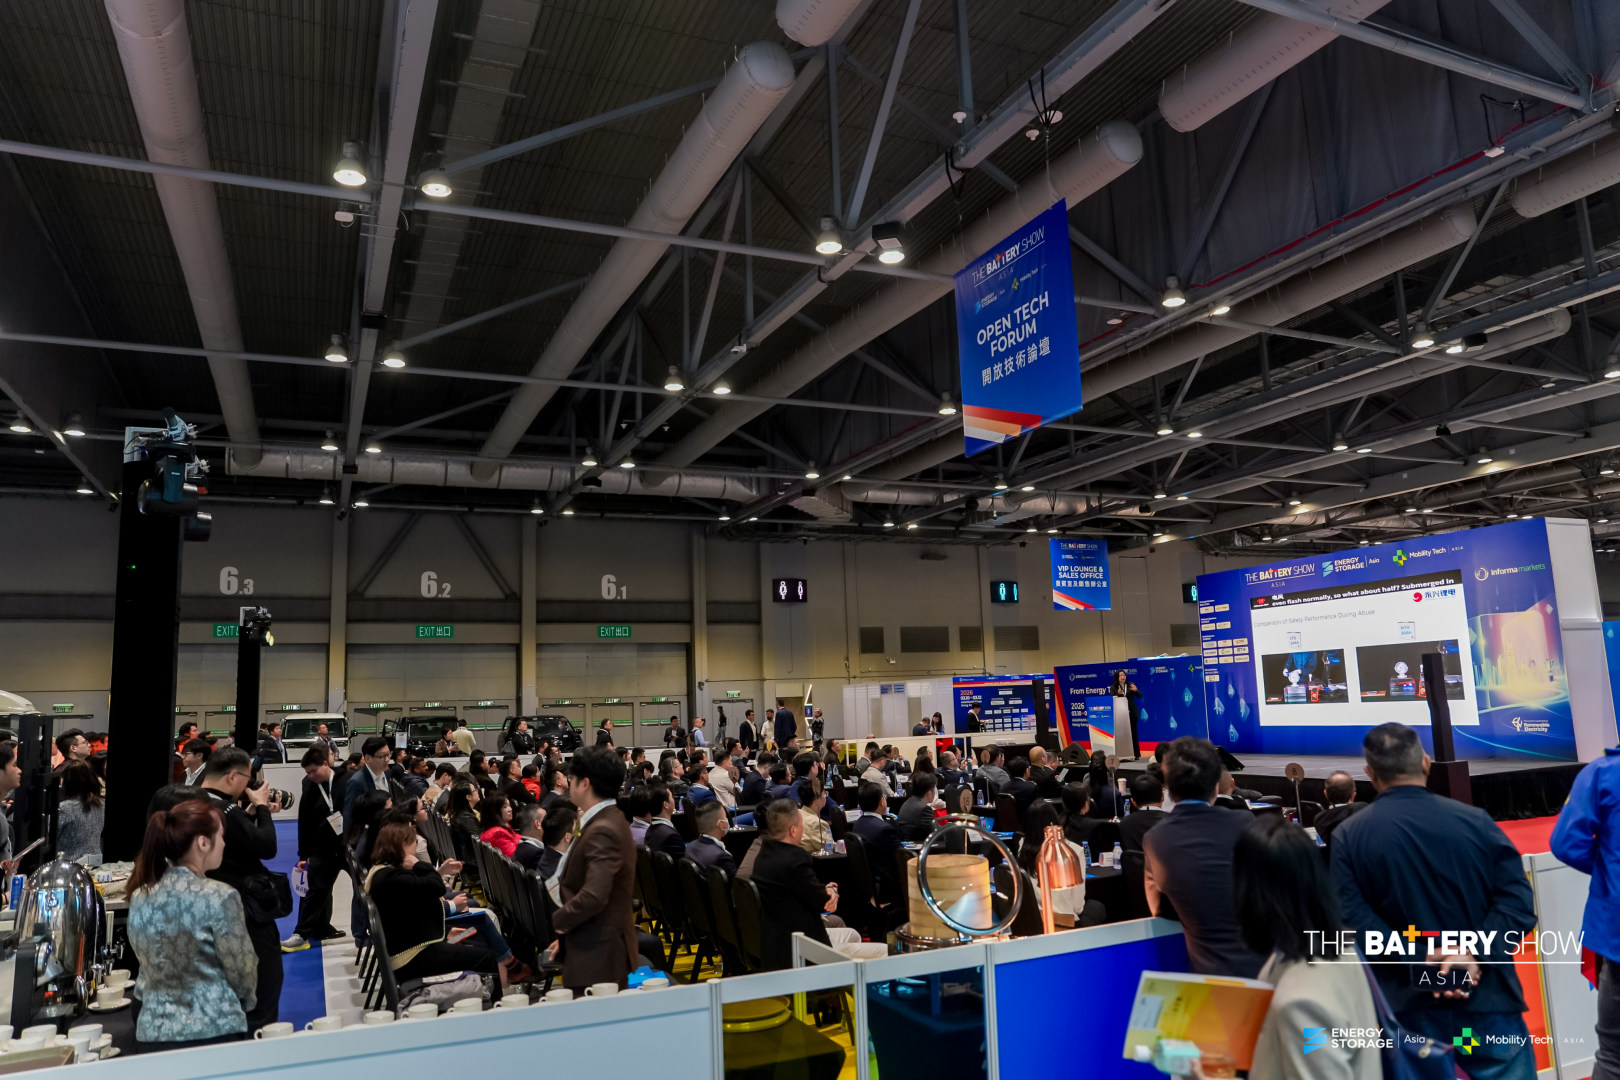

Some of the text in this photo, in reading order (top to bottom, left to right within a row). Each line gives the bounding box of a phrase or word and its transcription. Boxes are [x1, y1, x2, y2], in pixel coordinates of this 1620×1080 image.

[972, 225, 1045, 284] THE BATTERY SHOW
[977, 290, 1049, 345] OPEN TECH
[990, 317, 1037, 358] FORUM
[982, 336, 1051, 387] 開放技術論壇
[1334, 556, 1359, 566] ENERGY
[1409, 547, 1432, 559] Mobility
[1432, 546, 1447, 555] Tech
[1245, 562, 1316, 583] THE BATTERY SHOW
[1334, 562, 1365, 573] STORAGE
[1491, 563, 1546, 576] informa markets
[220, 566, 254, 595] 6.3
[420, 570, 452, 599] 6.2
[601, 574, 627, 600] 6.1
[1302, 594, 1333, 603] normally,
[1342, 589, 1360, 598] what
[1360, 587, 1381, 596] about
[1381, 584, 1400, 593] half?
[1401, 578, 1445, 590] Submerged
[1304, 613, 1337, 622] Performance
[217, 625, 235, 637] EXIT
[419, 626, 451, 637] EXIT 出口
[600, 626, 629, 637] EXIT 出口
[1085, 686, 1106, 696] Energy
